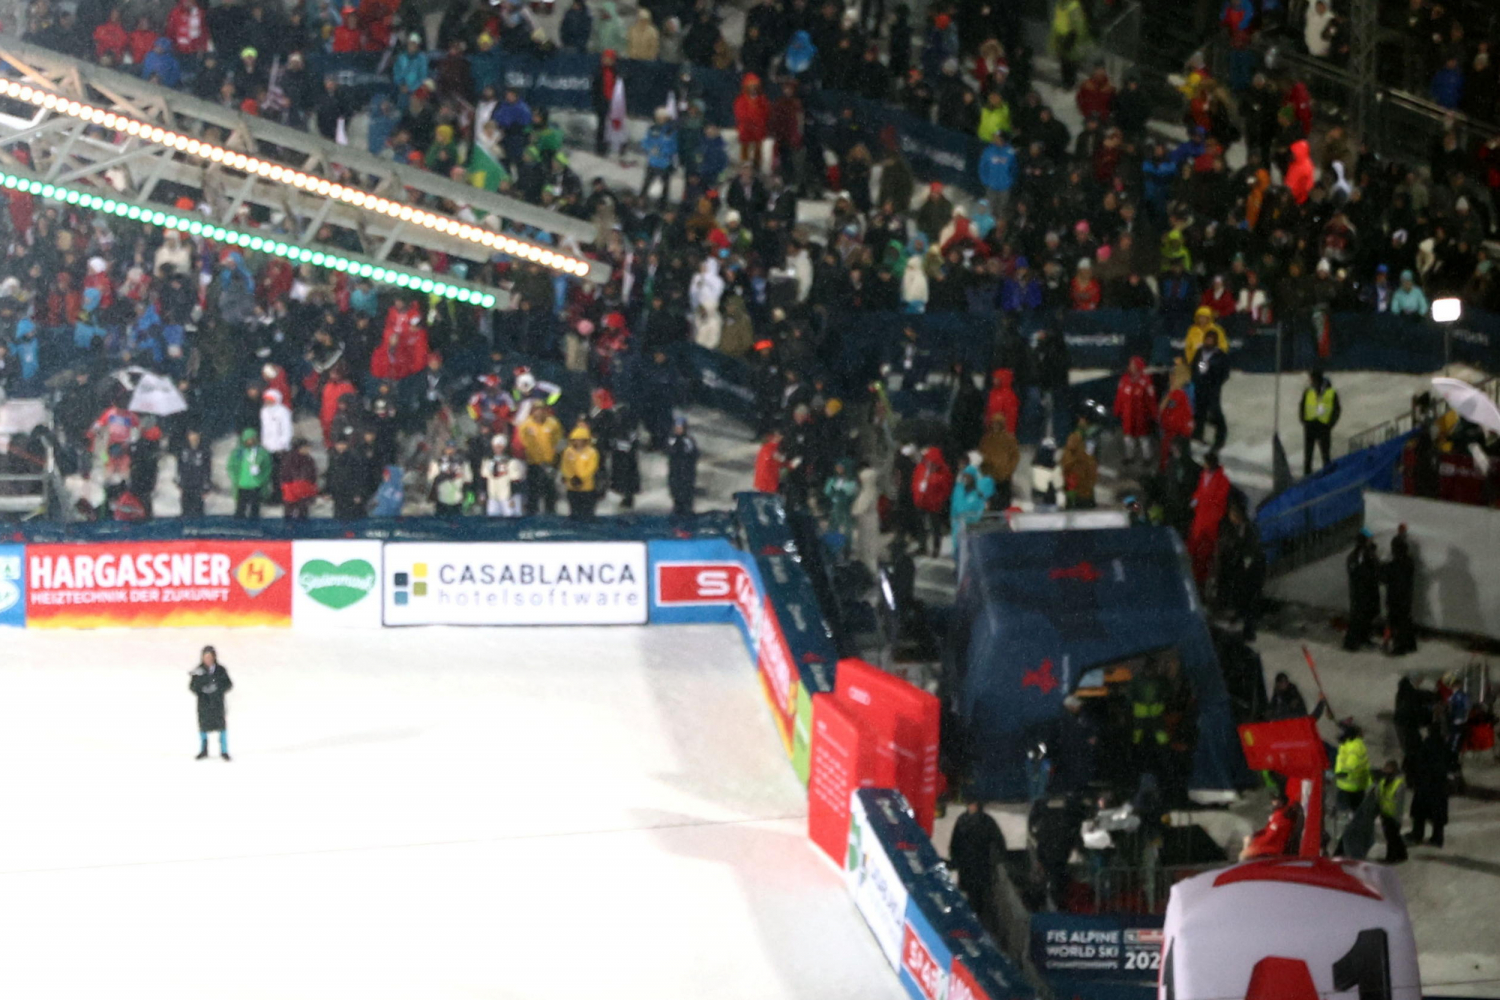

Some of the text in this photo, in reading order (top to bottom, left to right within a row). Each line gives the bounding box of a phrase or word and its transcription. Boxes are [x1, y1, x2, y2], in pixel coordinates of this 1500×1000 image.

[30, 553, 231, 589] HARGASSNER
[438, 563, 636, 586] CASABLANCA
[130, 589, 159, 603] DER
[162, 588, 230, 603] ZUKUNFT
[1046, 930, 1068, 944] FIS
[1070, 930, 1120, 944] ALPINE
[1046, 945, 1120, 959] WORLD SKI
[1124, 951, 1161, 970] 202
